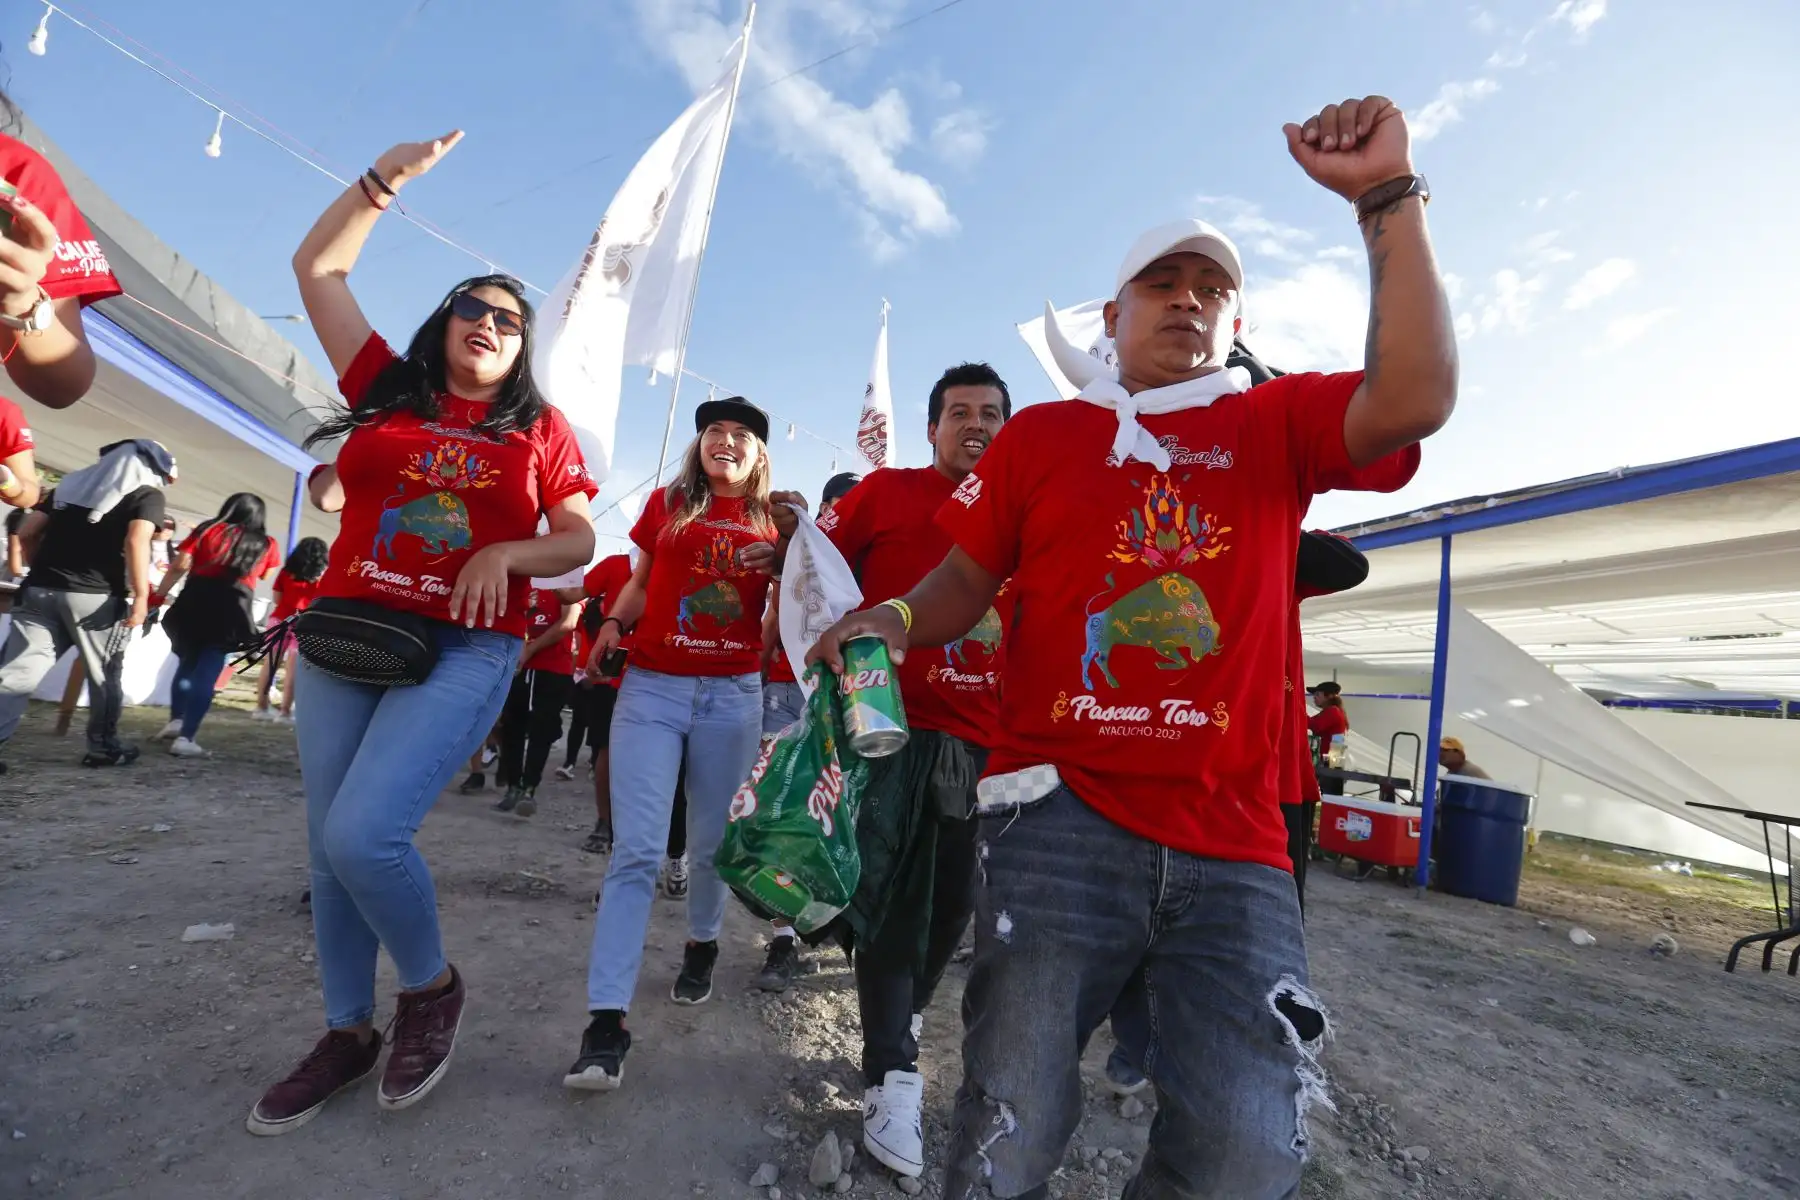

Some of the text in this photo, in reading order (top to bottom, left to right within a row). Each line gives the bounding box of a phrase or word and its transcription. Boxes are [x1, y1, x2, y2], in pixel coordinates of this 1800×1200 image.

[360, 560, 415, 587] Pascua
[370, 581, 431, 602] AYACUCHO 2023
[672, 634, 718, 648] Pascua
[939, 667, 985, 683] Pascua
[1070, 694, 1210, 727] Pascua Toro
[1098, 725, 1182, 741] AYACUCHO 2023
